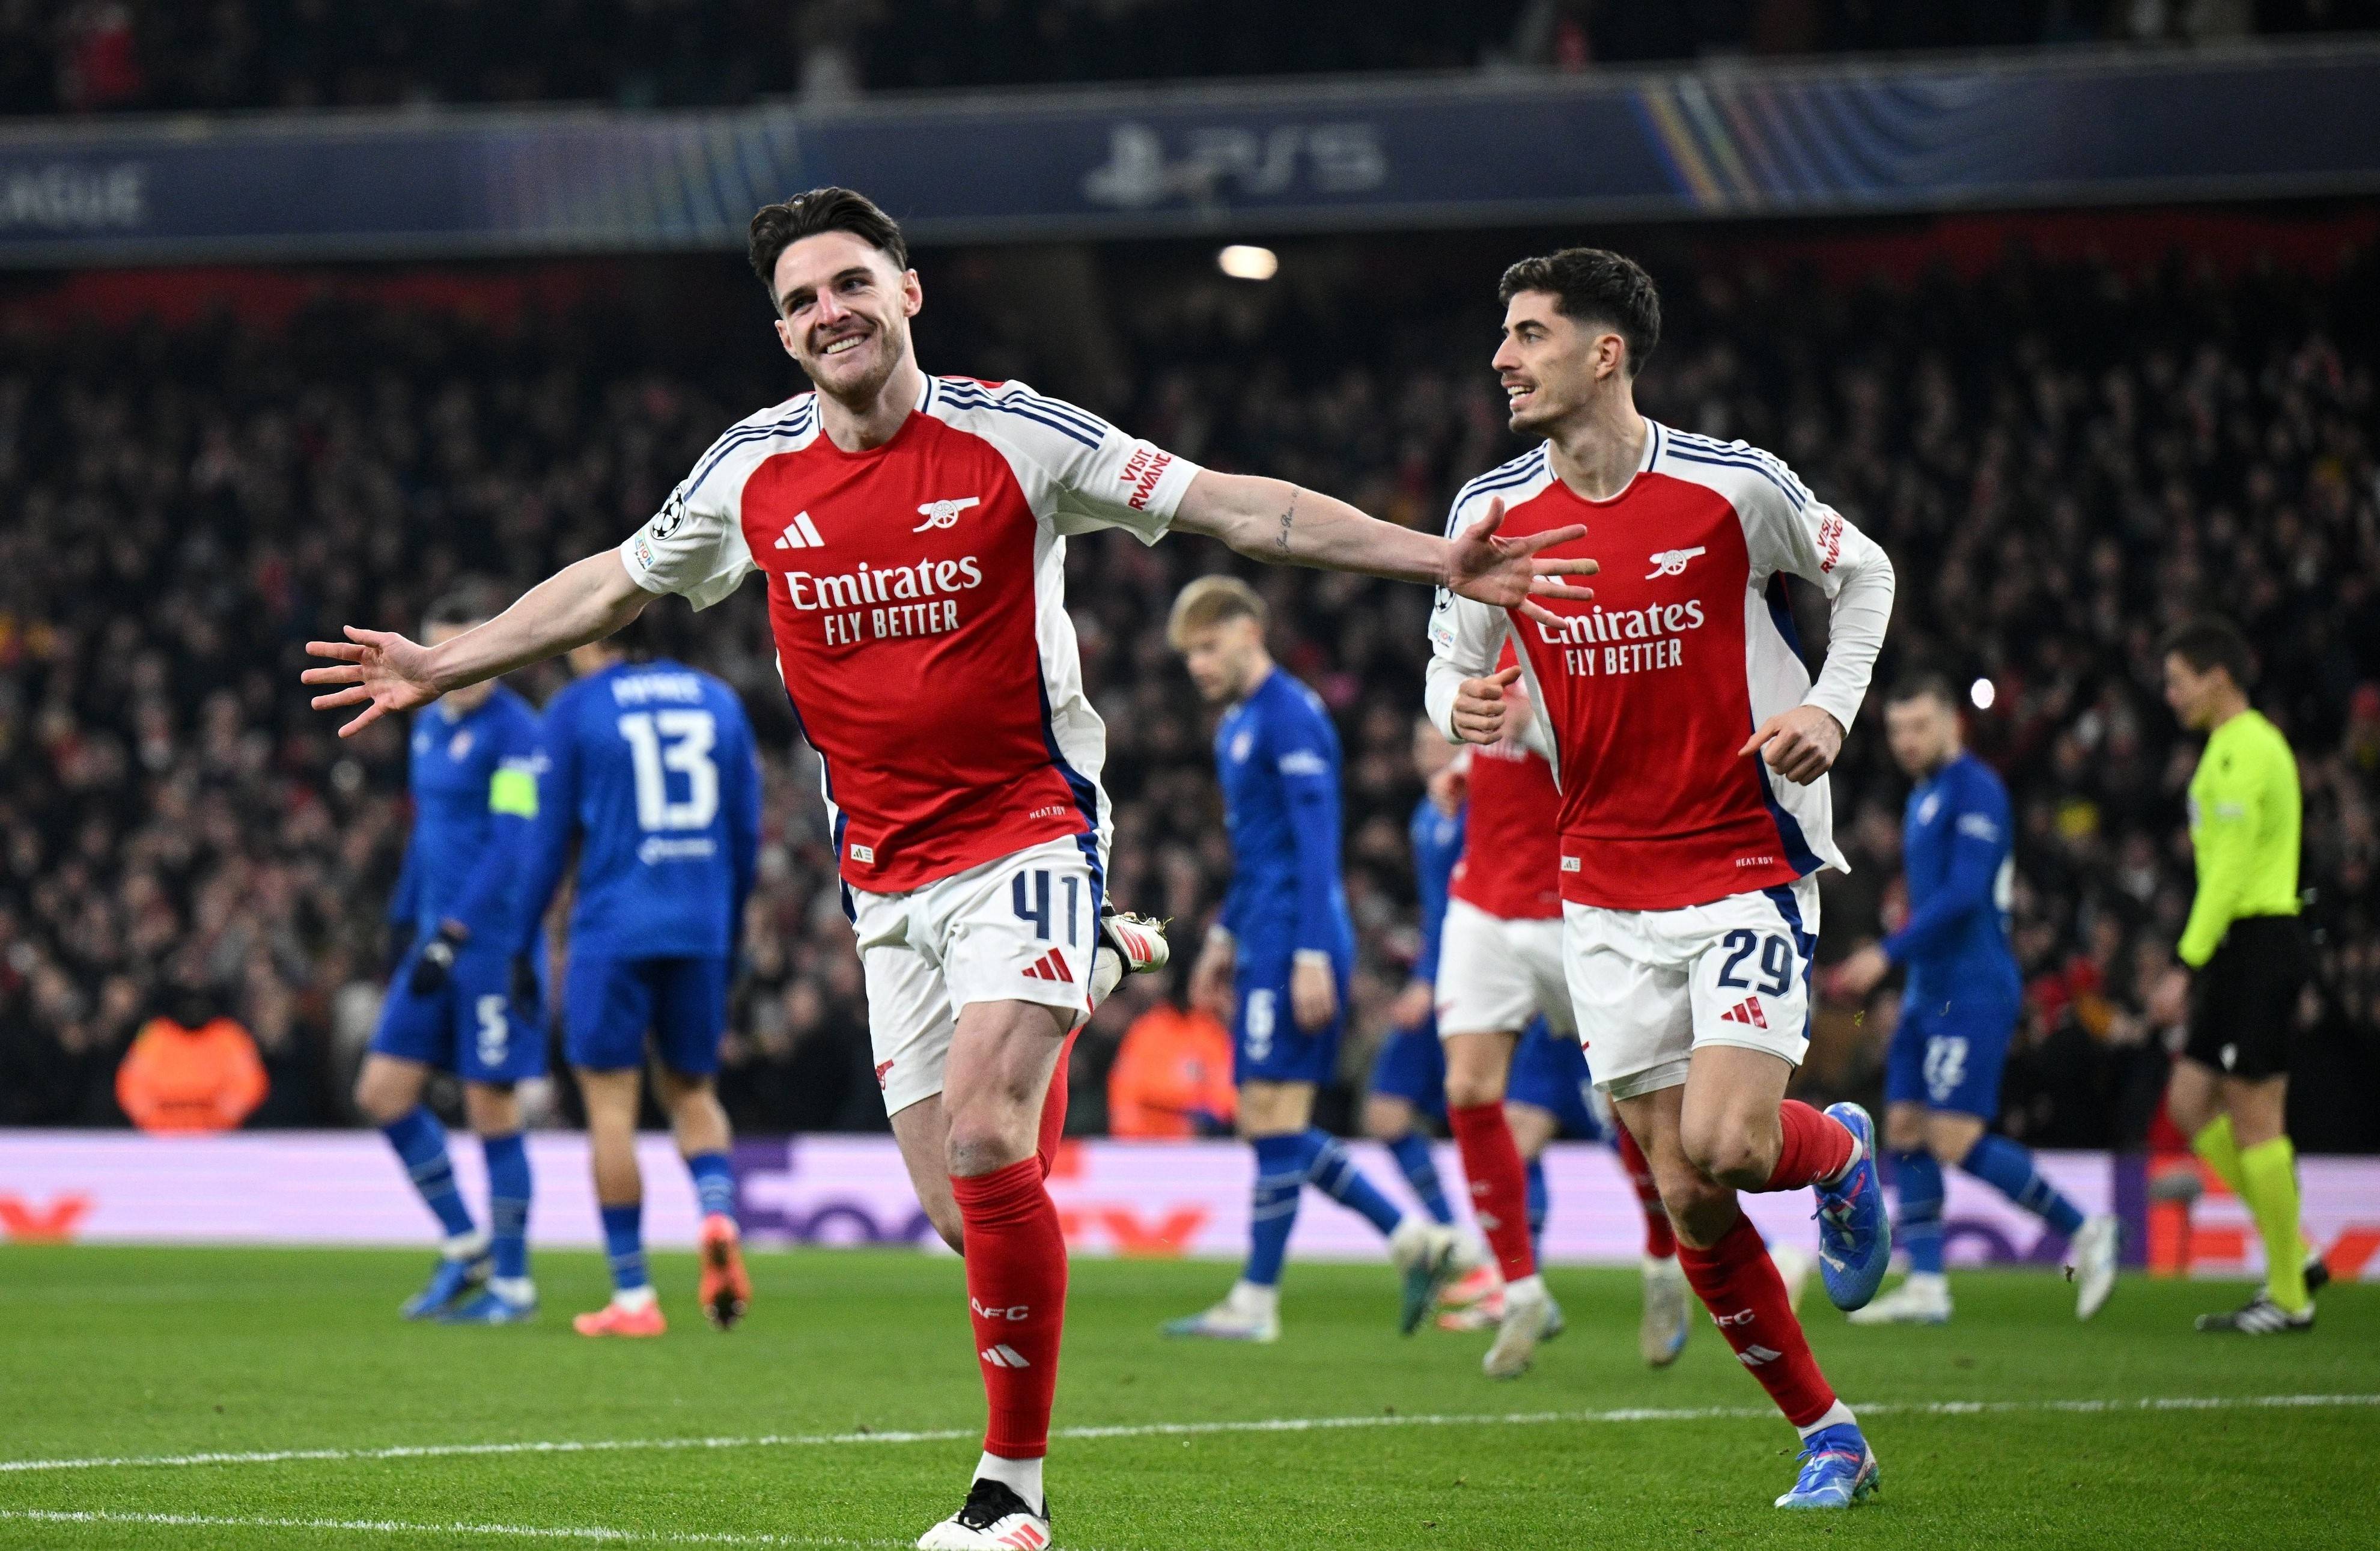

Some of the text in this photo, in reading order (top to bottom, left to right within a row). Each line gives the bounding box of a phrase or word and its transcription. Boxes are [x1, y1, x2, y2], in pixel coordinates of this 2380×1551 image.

[1119, 449, 1152, 481] VISIT
[1128, 453, 1173, 511] RWAN
[784, 556, 982, 611] Emirates
[824, 600, 959, 645] FLY BETTER
[1565, 638, 1682, 676] FLY BETTER
[618, 710, 719, 832] 13
[1736, 856, 1773, 868] HEAT.RDY
[1009, 868, 1080, 948] 41
[1717, 928, 1796, 999] 29
[476, 993, 509, 1045] 5
[972, 1297, 1029, 1321] AFC
